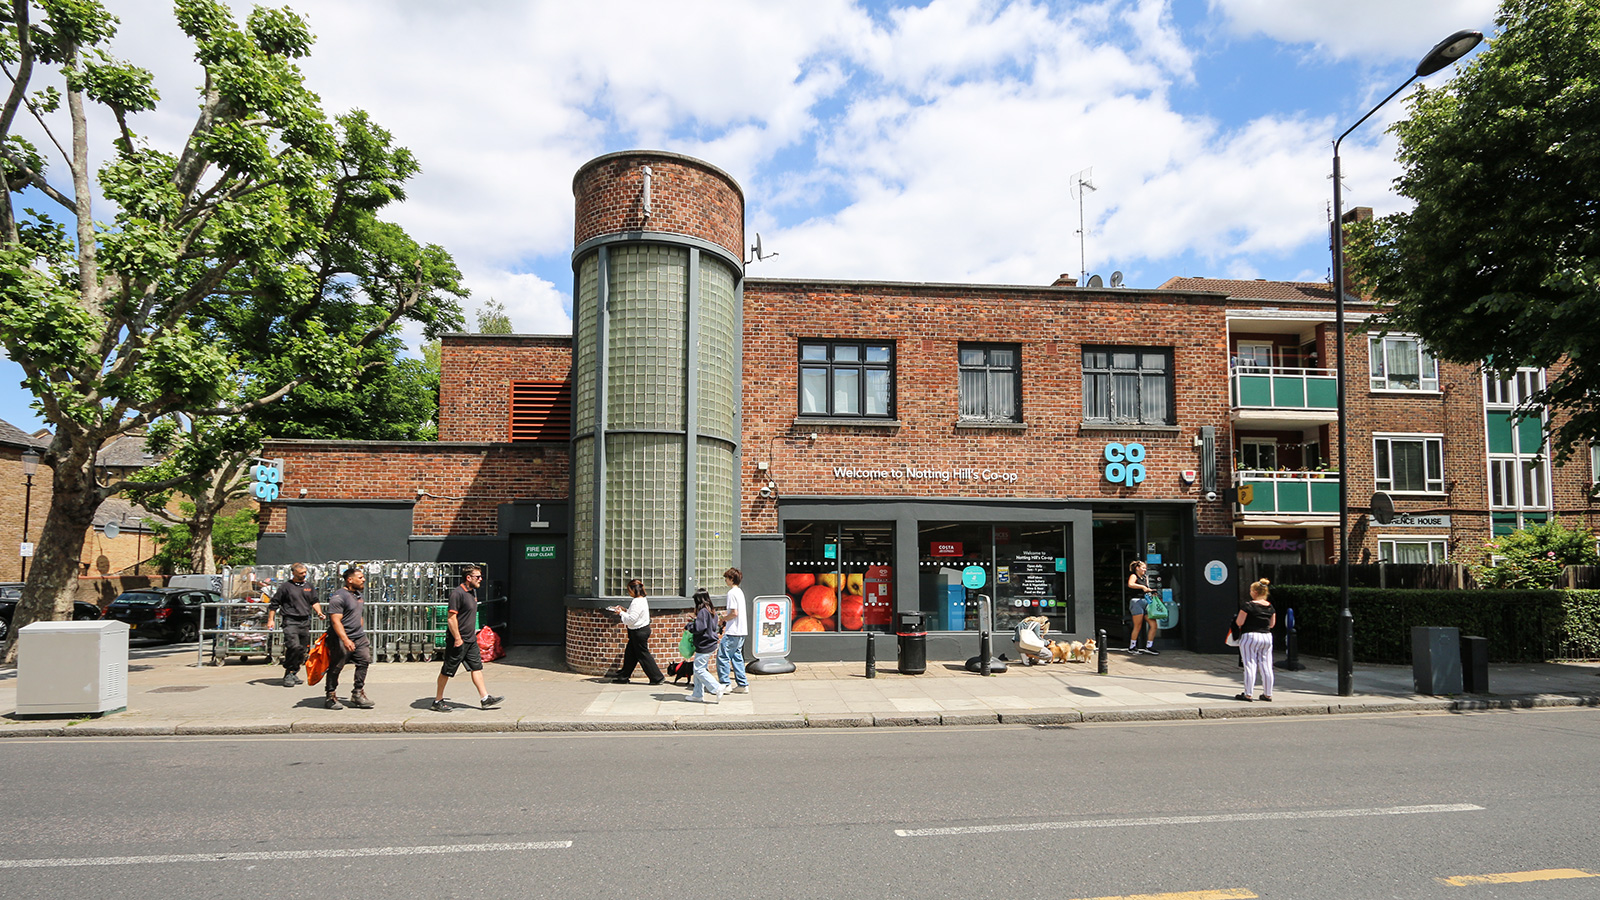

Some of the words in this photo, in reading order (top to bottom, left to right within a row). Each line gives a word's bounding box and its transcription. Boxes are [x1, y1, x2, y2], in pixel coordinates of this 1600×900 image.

[833, 466, 888, 479] Welcome
[891, 467, 902, 479] to
[906, 467, 949, 482] Notting
[953, 467, 979, 480] Hill's
[982, 469, 1018, 483] Co-op
